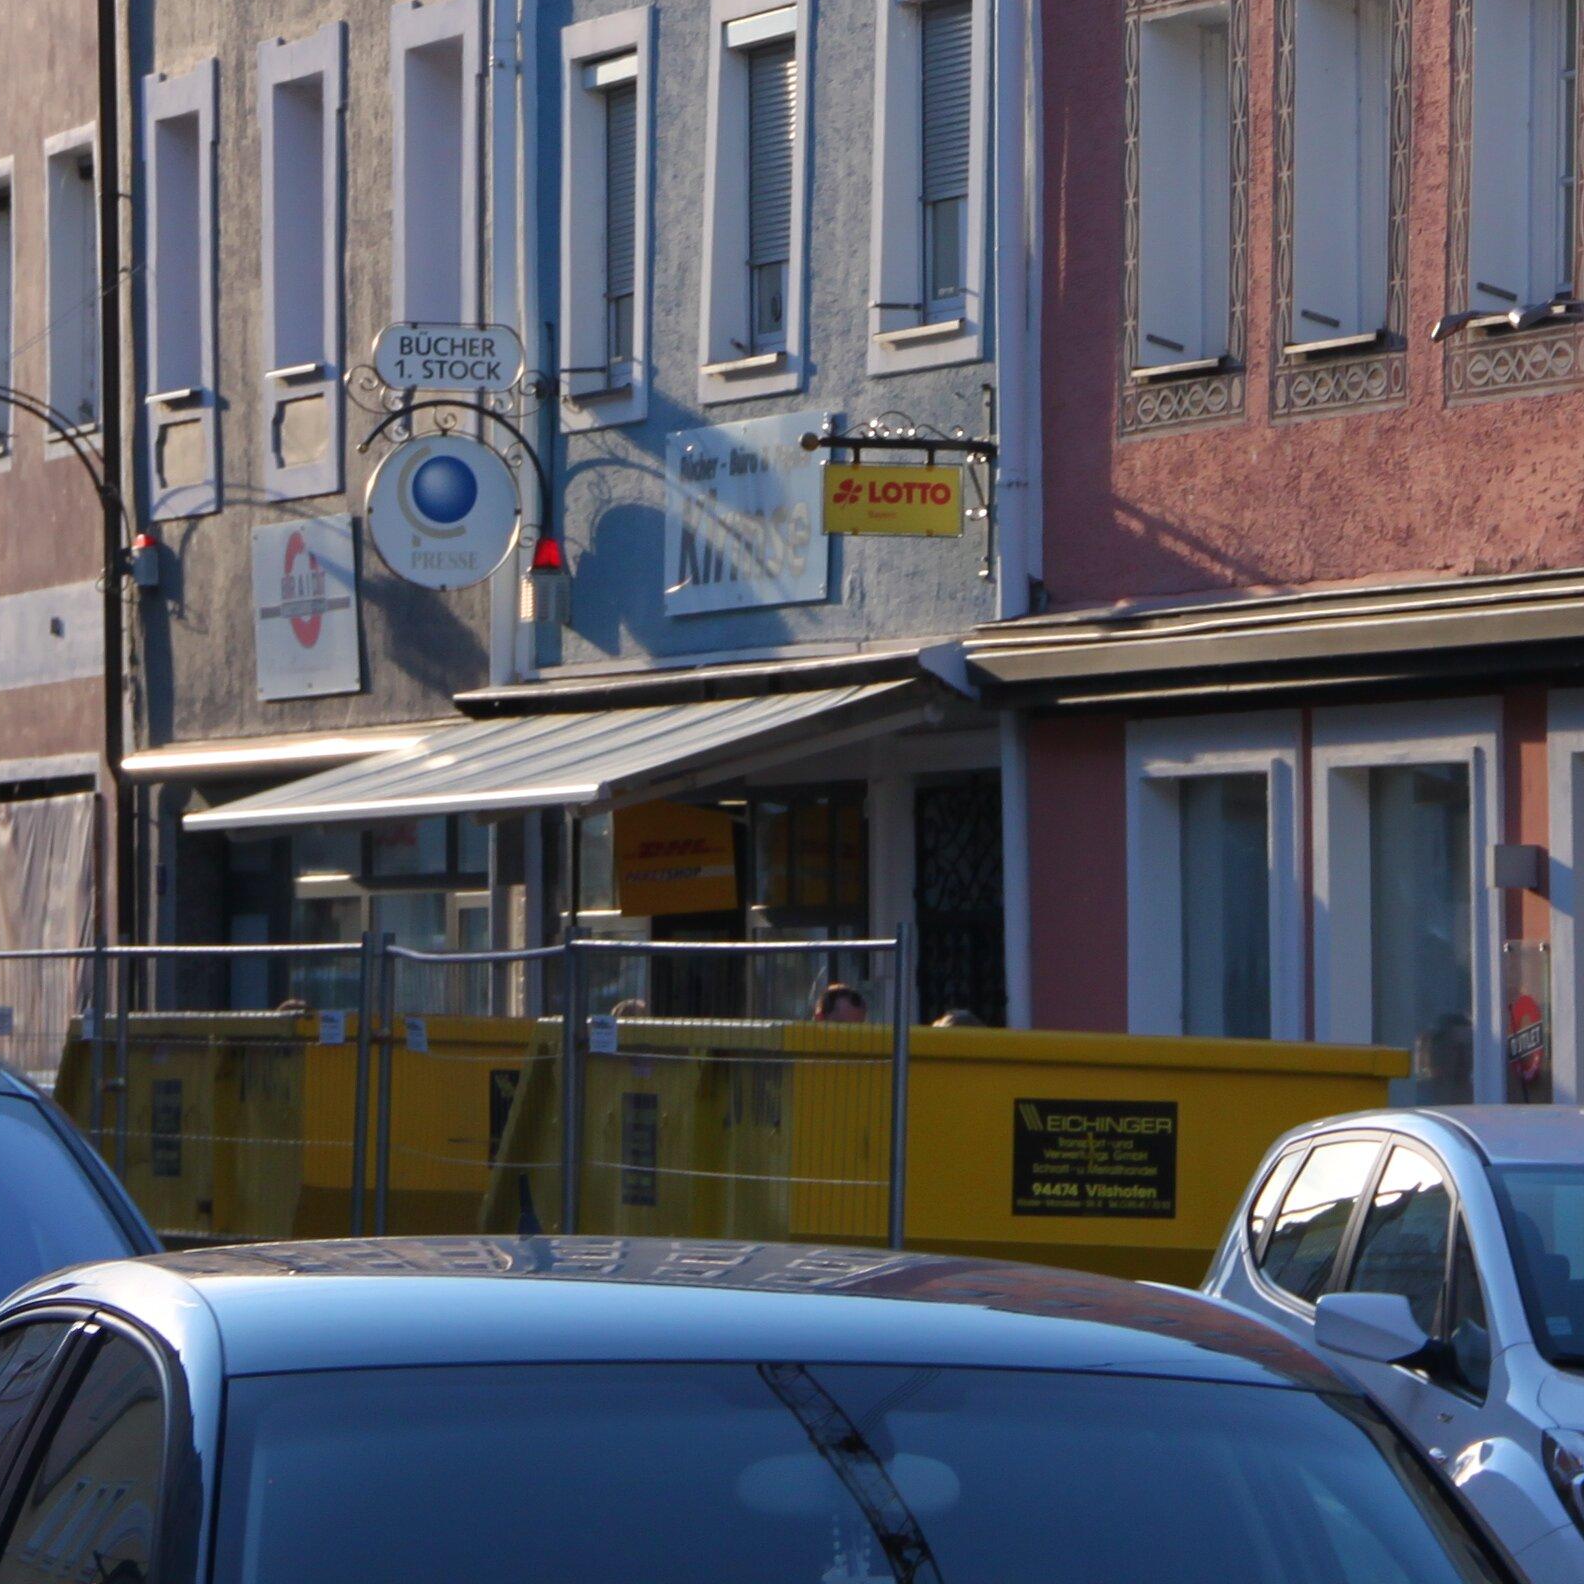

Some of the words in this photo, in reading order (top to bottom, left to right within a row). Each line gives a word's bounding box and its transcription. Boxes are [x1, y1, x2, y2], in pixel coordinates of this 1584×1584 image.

[399, 330, 496, 357] BÜCHER
[395, 359, 413, 379] 1.
[422, 360, 501, 380] STOCK
[868, 481, 952, 506] LOTTO
[411, 549, 478, 571] PRESSE
[1047, 1115, 1173, 1134] EICHINGER
[1032, 1181, 1079, 1197] 94474
[1085, 1182, 1157, 1199] Vilshofen
